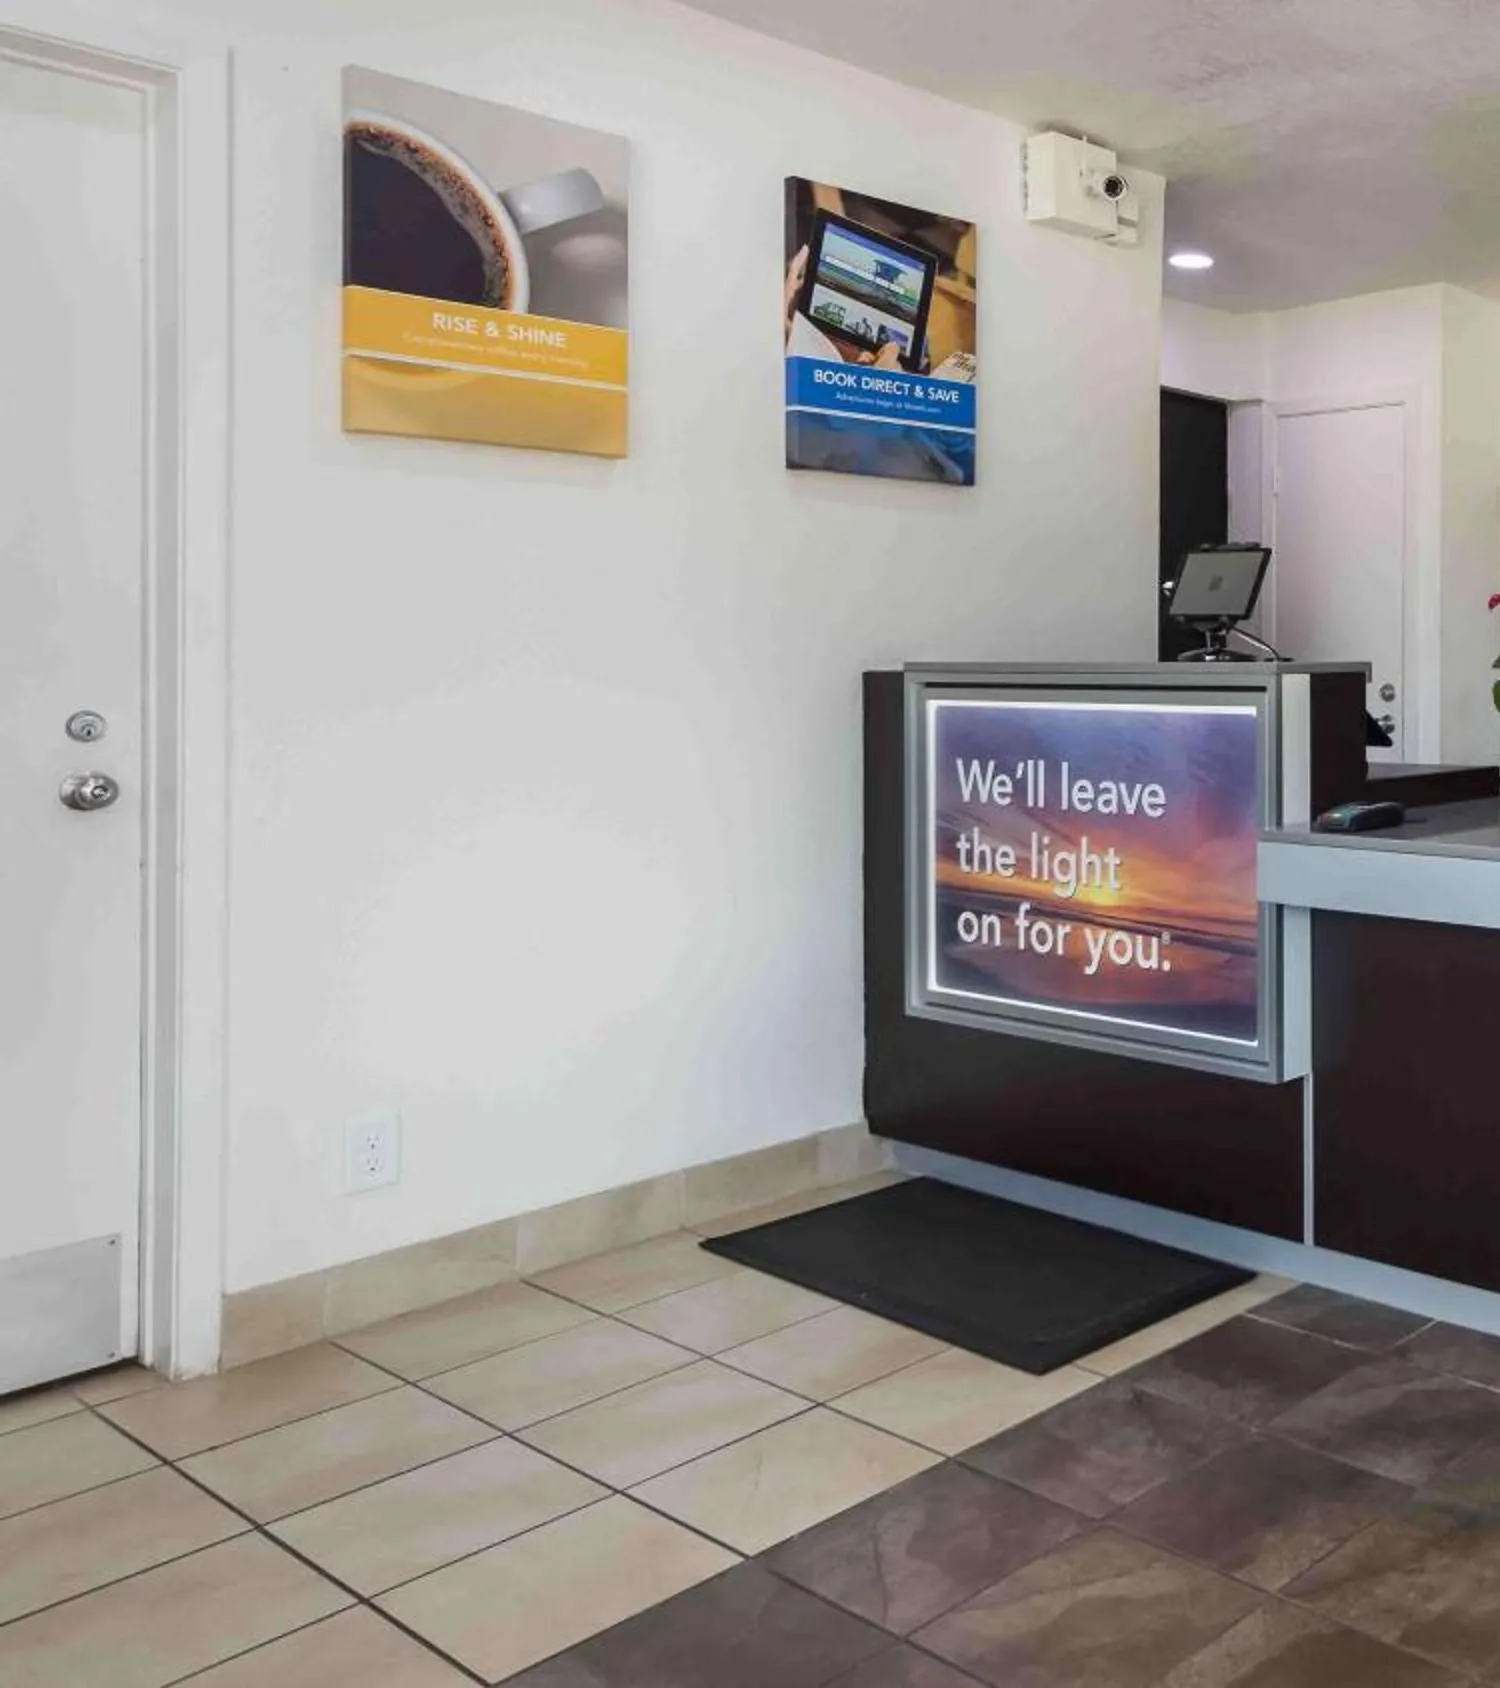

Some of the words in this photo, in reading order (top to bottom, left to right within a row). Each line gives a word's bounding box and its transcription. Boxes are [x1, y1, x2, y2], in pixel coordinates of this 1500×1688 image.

[432, 312, 480, 335] RISE
[485, 321, 499, 337] &
[508, 324, 568, 347] SHINE
[813, 369, 857, 388] BOOK
[861, 377, 910, 396] DIRECT
[914, 385, 924, 398] &
[927, 387, 960, 403] SAVE
[956, 757, 1045, 808] We'll
[1061, 761, 1167, 818] leave
[956, 826, 1016, 877] the
[1031, 831, 1121, 898] light
[957, 911, 1001, 947] on
[1015, 901, 1071, 956] for
